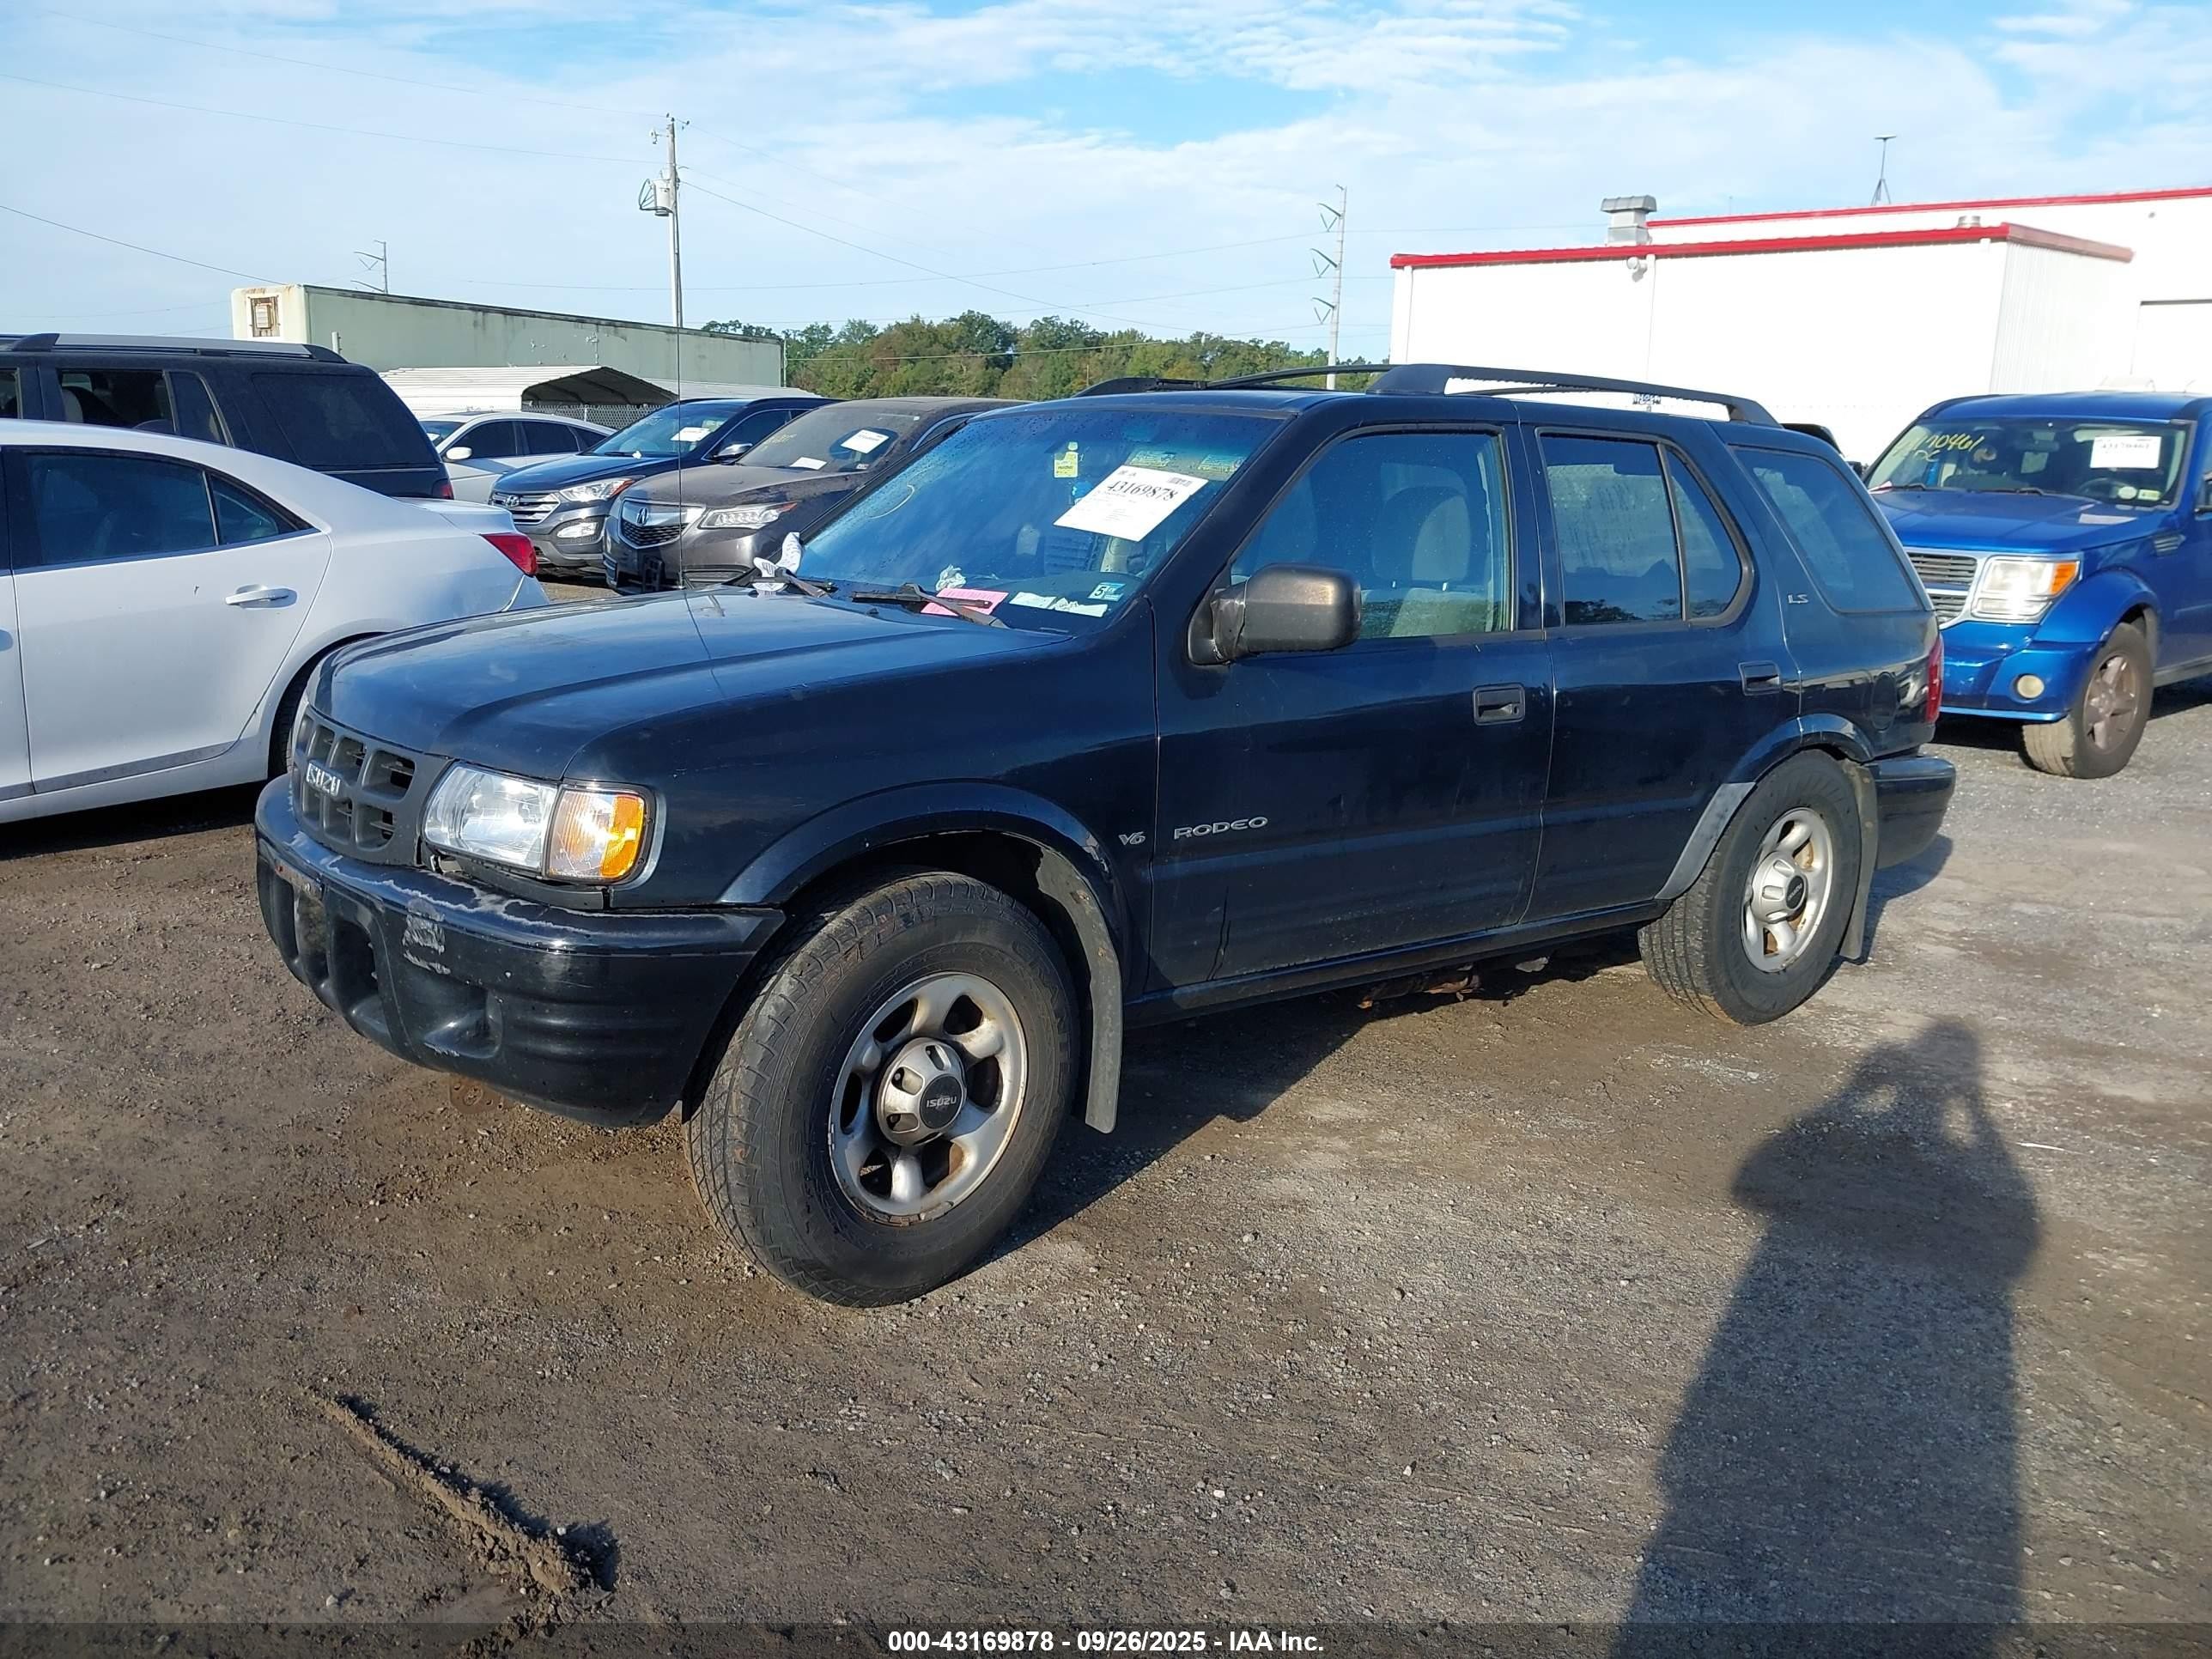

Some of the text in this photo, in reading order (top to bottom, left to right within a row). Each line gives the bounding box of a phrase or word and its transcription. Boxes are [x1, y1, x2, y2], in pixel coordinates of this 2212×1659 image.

[1107, 480, 1179, 501] 43169878
[1787, 593, 1809, 605] LS
[306, 763, 341, 796] ISUZU
[1173, 816, 1269, 841] RODEO
[1118, 830, 1147, 846] V6
[926, 1095, 957, 1109] ISUZU
